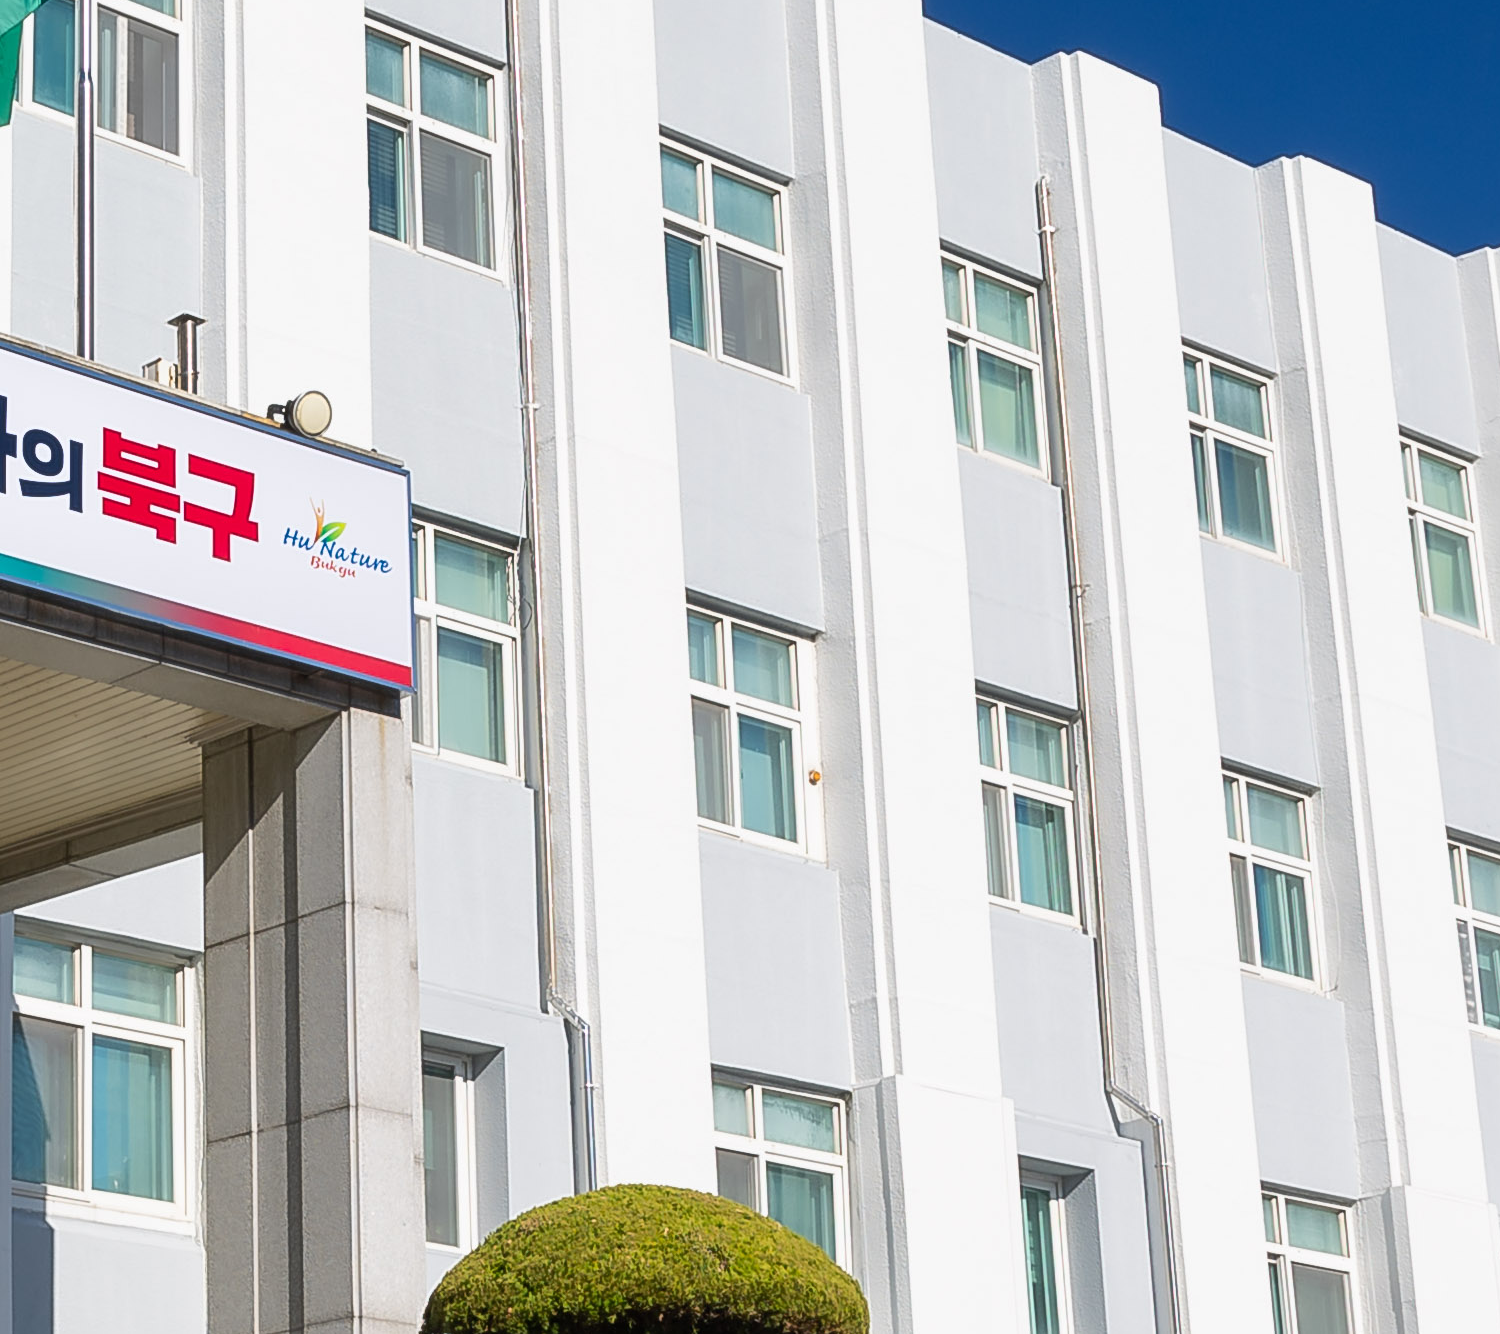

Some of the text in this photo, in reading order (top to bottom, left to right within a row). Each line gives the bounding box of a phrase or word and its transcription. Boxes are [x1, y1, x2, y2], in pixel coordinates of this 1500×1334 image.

[95, 427, 260, 562] 북구
[283, 527, 392, 574] Hu Nature
[310, 555, 356, 578] Bukgu
